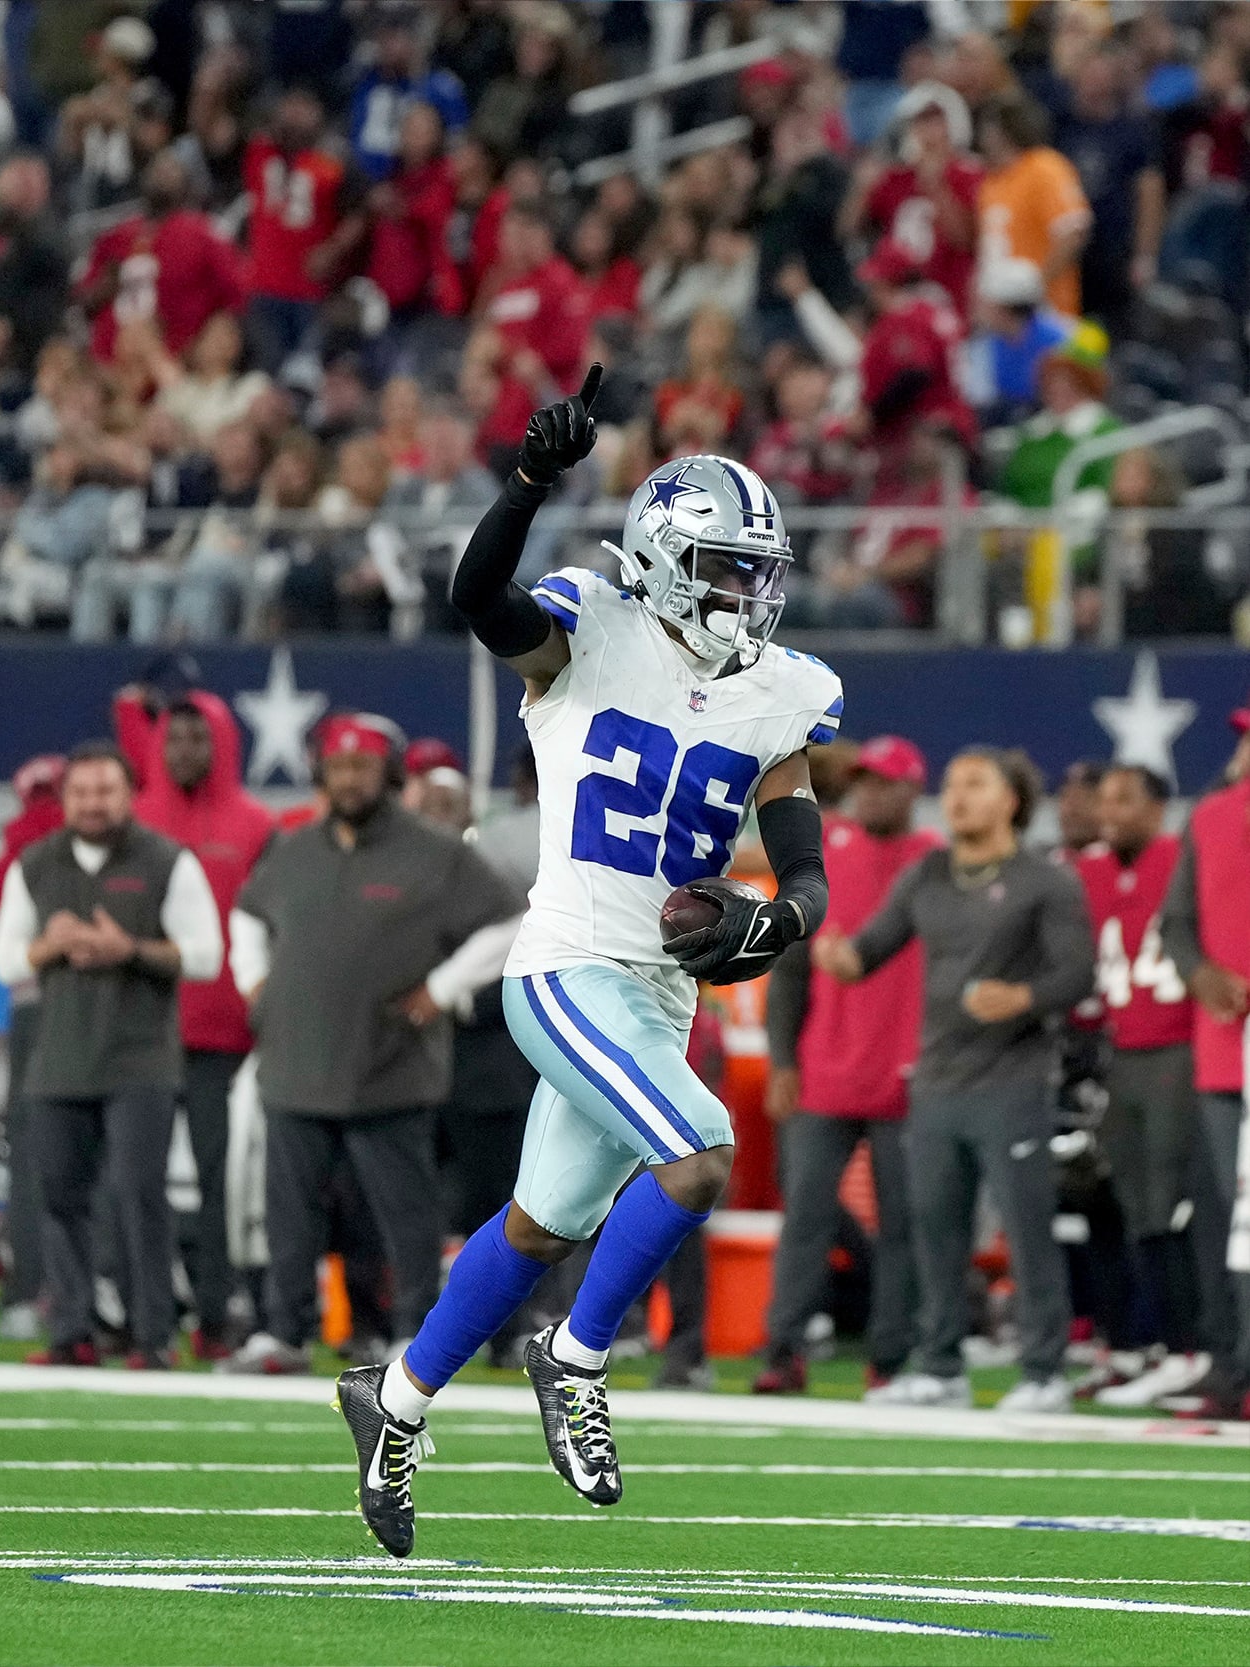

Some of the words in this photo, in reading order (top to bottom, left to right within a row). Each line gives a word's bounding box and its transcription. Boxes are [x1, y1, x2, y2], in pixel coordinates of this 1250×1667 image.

[747, 530, 775, 542] COWBOYS
[570, 706, 760, 888] 26
[1094, 913, 1187, 1008] 44
